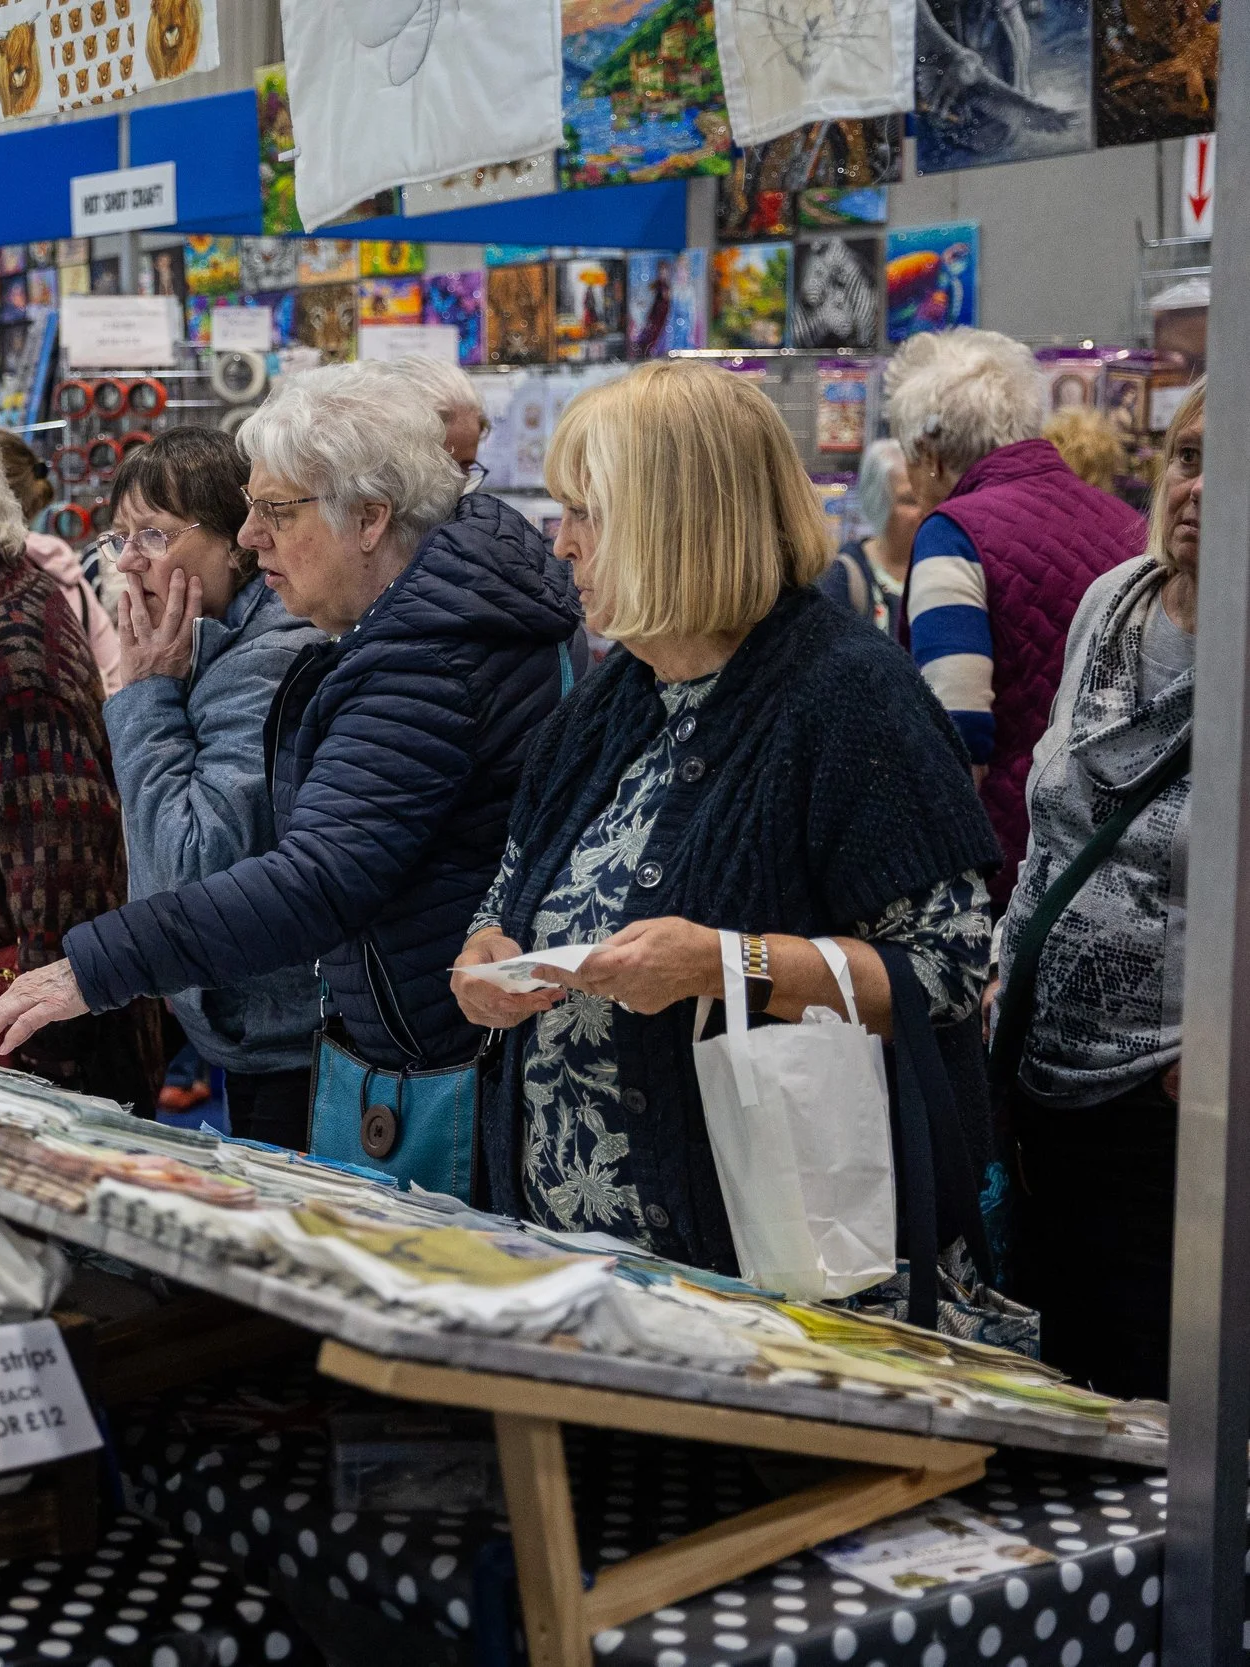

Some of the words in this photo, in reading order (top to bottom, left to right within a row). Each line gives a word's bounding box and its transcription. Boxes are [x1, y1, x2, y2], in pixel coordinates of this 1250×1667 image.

[83, 193, 100, 215] HOT
[132, 184, 164, 208] CRAFT
[0, 1349, 58, 1372] strips
[26, 1406, 66, 1432] £12
